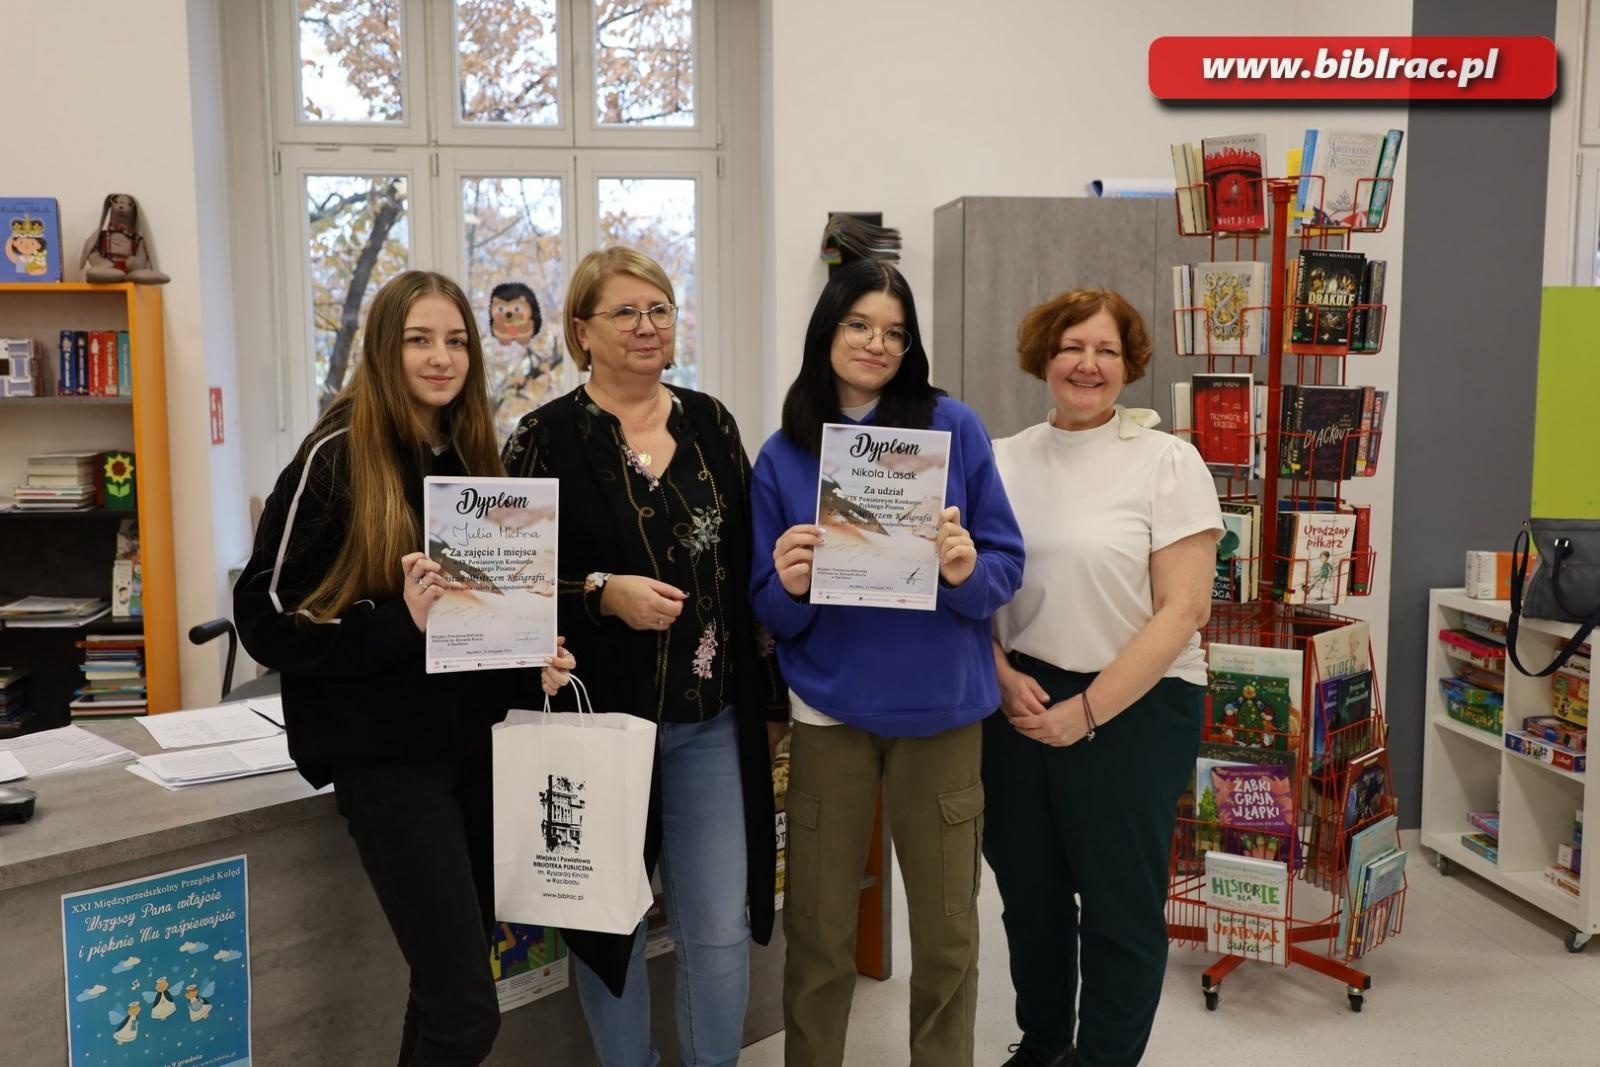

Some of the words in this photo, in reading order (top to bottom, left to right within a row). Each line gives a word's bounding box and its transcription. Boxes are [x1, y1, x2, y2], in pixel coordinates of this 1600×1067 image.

[850, 433, 922, 463] Dyplom
[851, 468, 884, 479] Nikola
[887, 469, 917, 480] Lasak
[863, 486, 875, 495] Za
[877, 486, 904, 496] udział
[456, 487, 529, 519] Dyplom
[452, 522, 493, 547] Julia
[1304, 525, 1350, 539] Urodzony
[1306, 537, 1343, 550] piłkarz
[450, 548, 461, 557] Za
[464, 547, 495, 558] zajęcie
[503, 547, 537, 558] miejsca
[1233, 777, 1271, 793] ŻABKI
[1234, 792, 1275, 806] GRAJĄ
[1244, 805, 1280, 820] ŁAPKI
[533, 861, 562, 870] BIBLIOTEKA
[563, 864, 593, 872] PUBLICZNA
[560, 855, 591, 864] Powiatowa
[546, 870, 571, 878] Ryszarda
[552, 877, 580, 886] Raciborzu
[71, 903, 92, 915] XXI
[94, 882, 179, 910] Międzyprzedszkolny
[181, 873, 215, 888] Przegląd
[216, 867, 241, 881] Kolęd
[542, 892, 584, 900] www.biblrac.pl
[1211, 877, 1280, 905] HISTORIE
[84, 912, 136, 933] Wszyscy
[141, 903, 173, 919] Pana
[177, 888, 222, 909] witajcie
[78, 945, 84, 959] i
[87, 938, 136, 962] pięknie
[139, 926, 160, 943] Mu
[164, 907, 237, 940] zaśpiewajcie
[1213, 922, 1280, 945] URATOWAĆ
